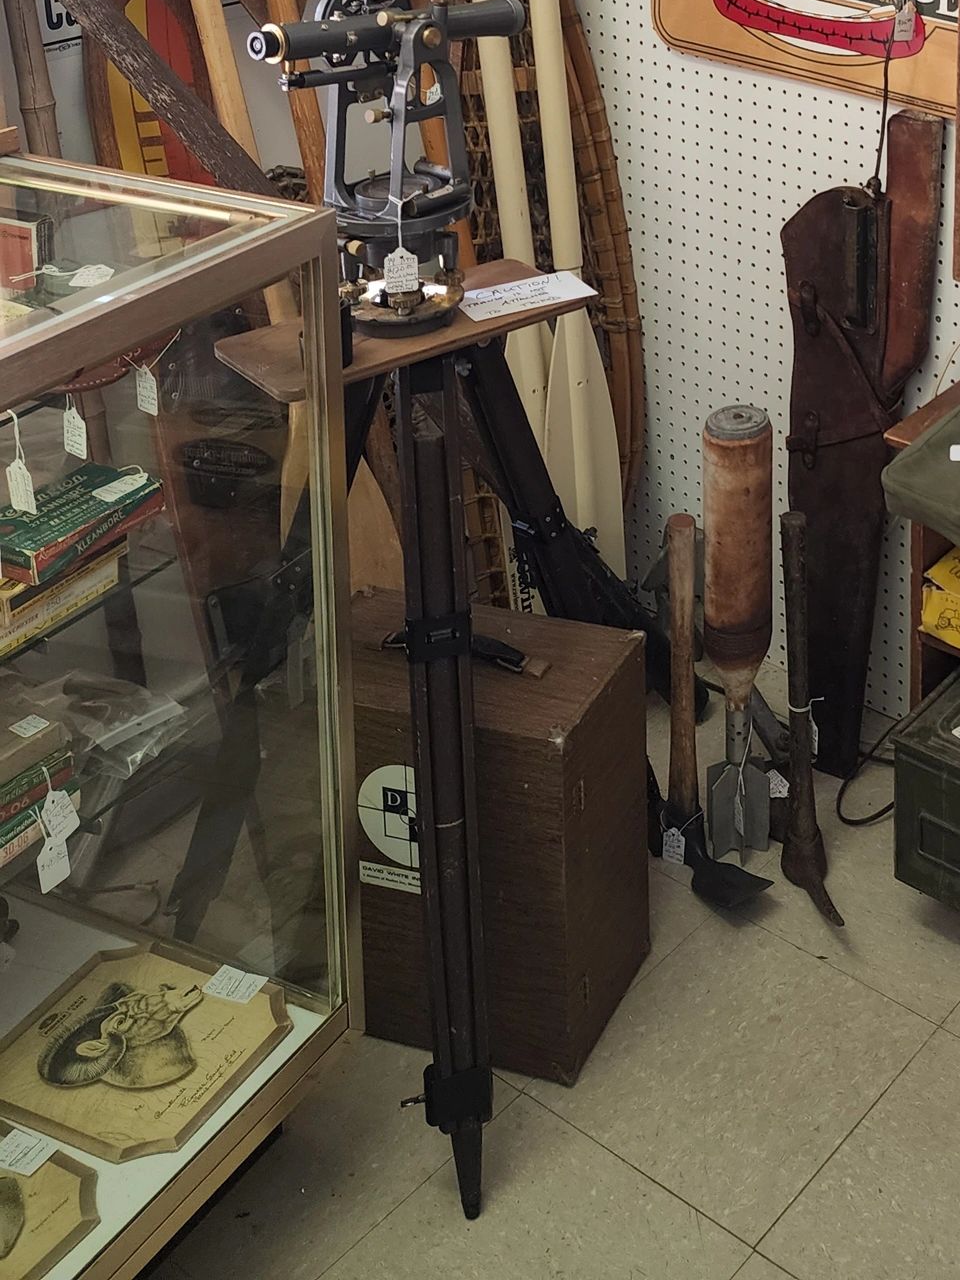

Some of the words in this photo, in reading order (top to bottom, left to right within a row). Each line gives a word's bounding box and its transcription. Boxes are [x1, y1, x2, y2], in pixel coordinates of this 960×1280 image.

[386, 791, 401, 807] D
[362, 865, 384, 874] DAVID
[386, 870, 409, 880] WHITE
